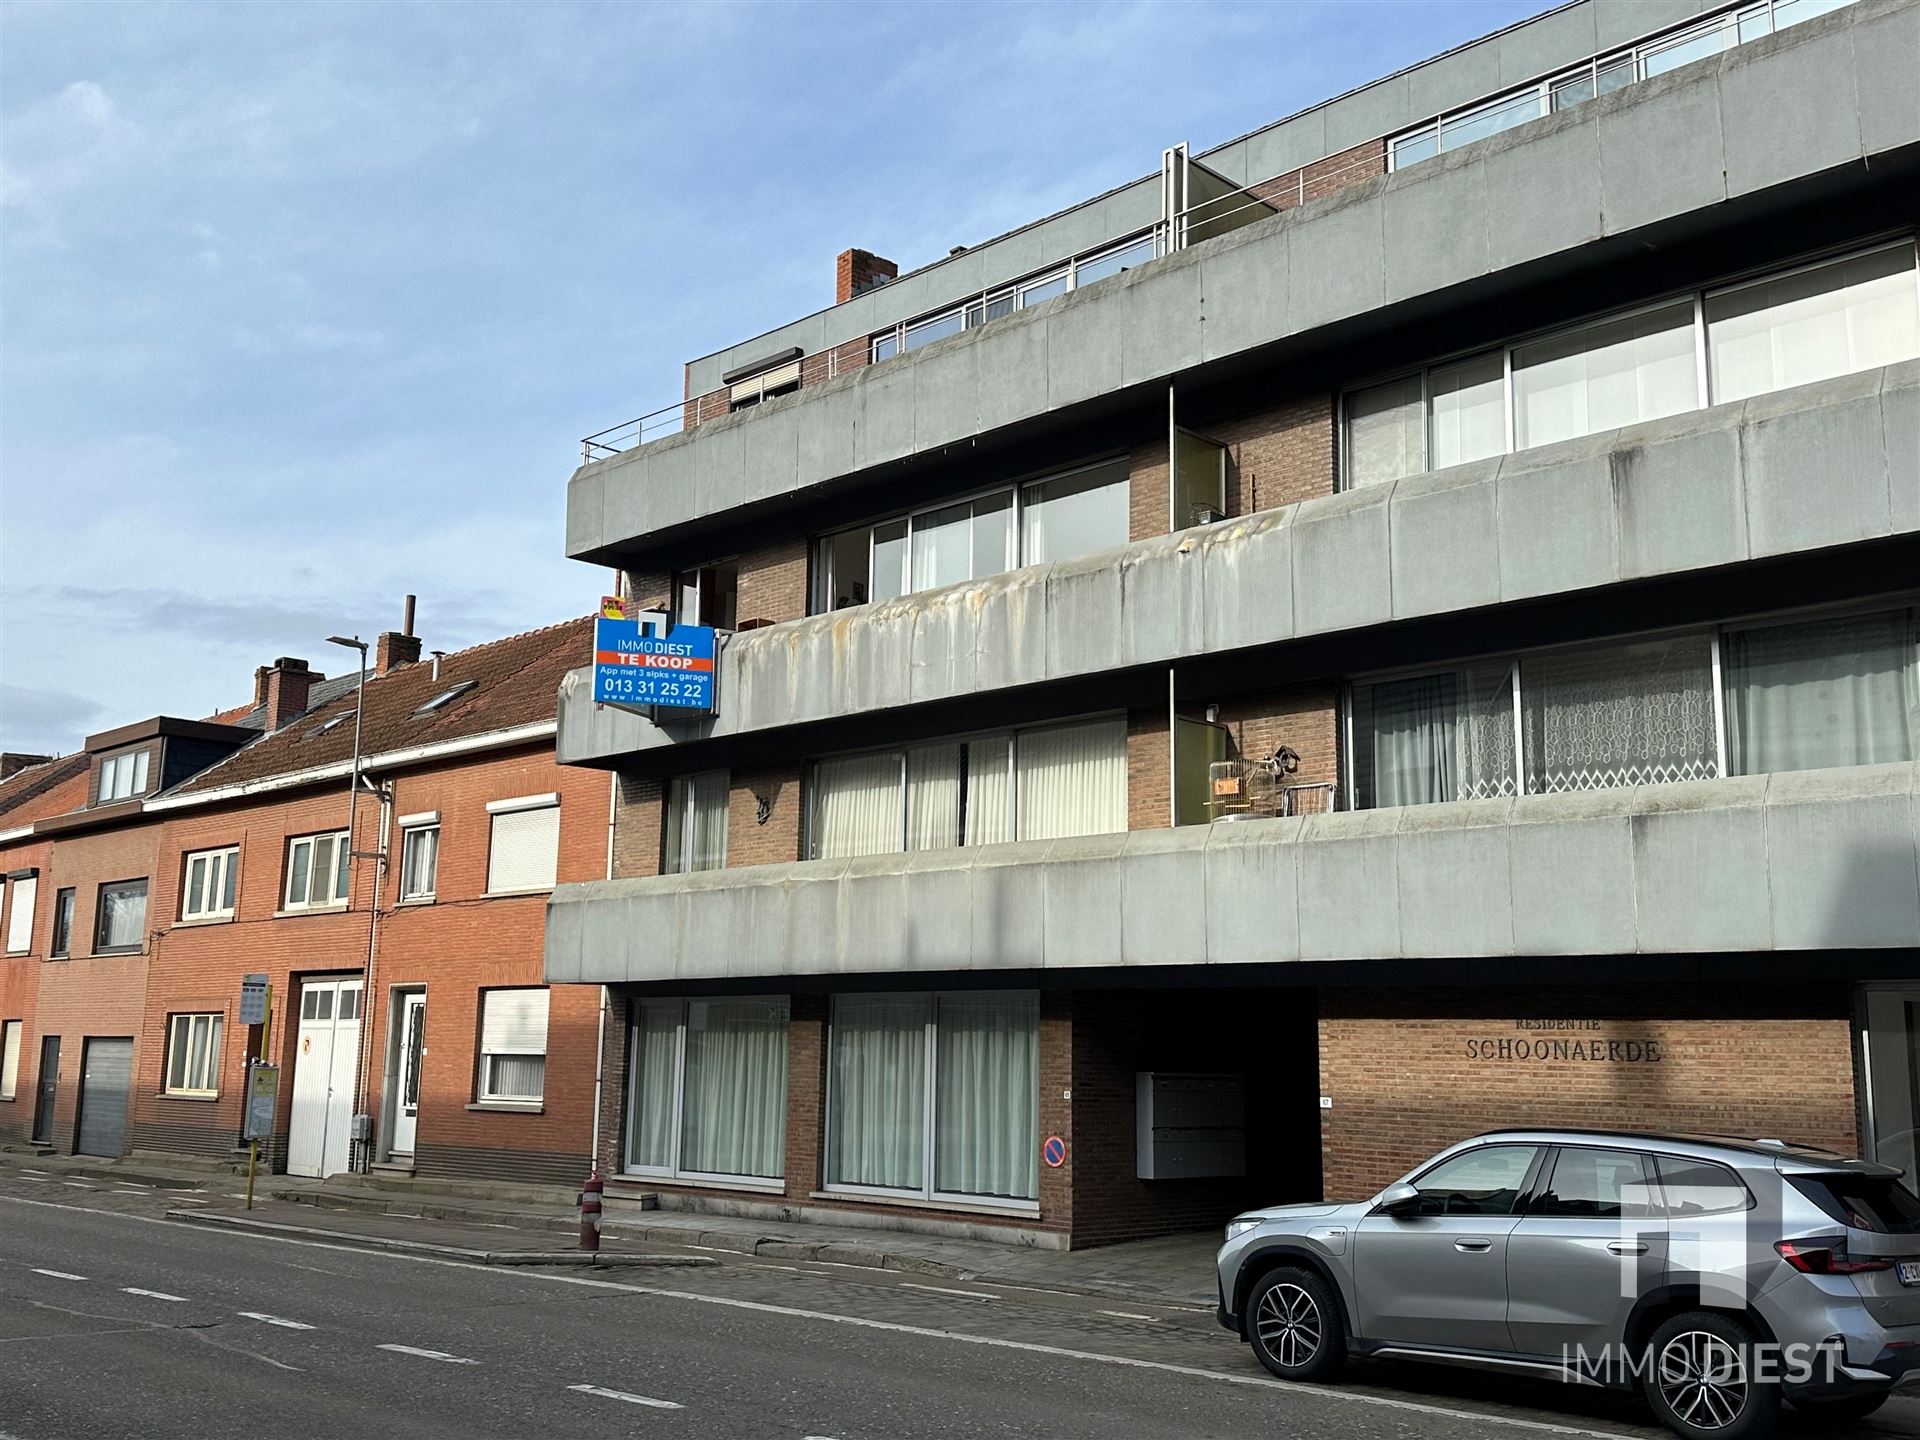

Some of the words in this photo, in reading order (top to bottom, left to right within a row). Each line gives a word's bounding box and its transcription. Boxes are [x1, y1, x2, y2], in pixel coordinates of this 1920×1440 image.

[617, 652, 640, 666] TE
[645, 655, 693, 669] KOOP
[600, 666, 618, 675] App
[620, 668, 637, 676] met
[639, 669, 644, 677] 3
[679, 674, 708, 683] garage
[605, 678, 633, 693] 013
[638, 681, 654, 694] 31
[661, 682, 680, 696] 25
[683, 684, 702, 698] 22
[1515, 1019, 1601, 1031] RESIDENTIE
[1466, 1038, 1662, 1063] SCHOONAERDE
